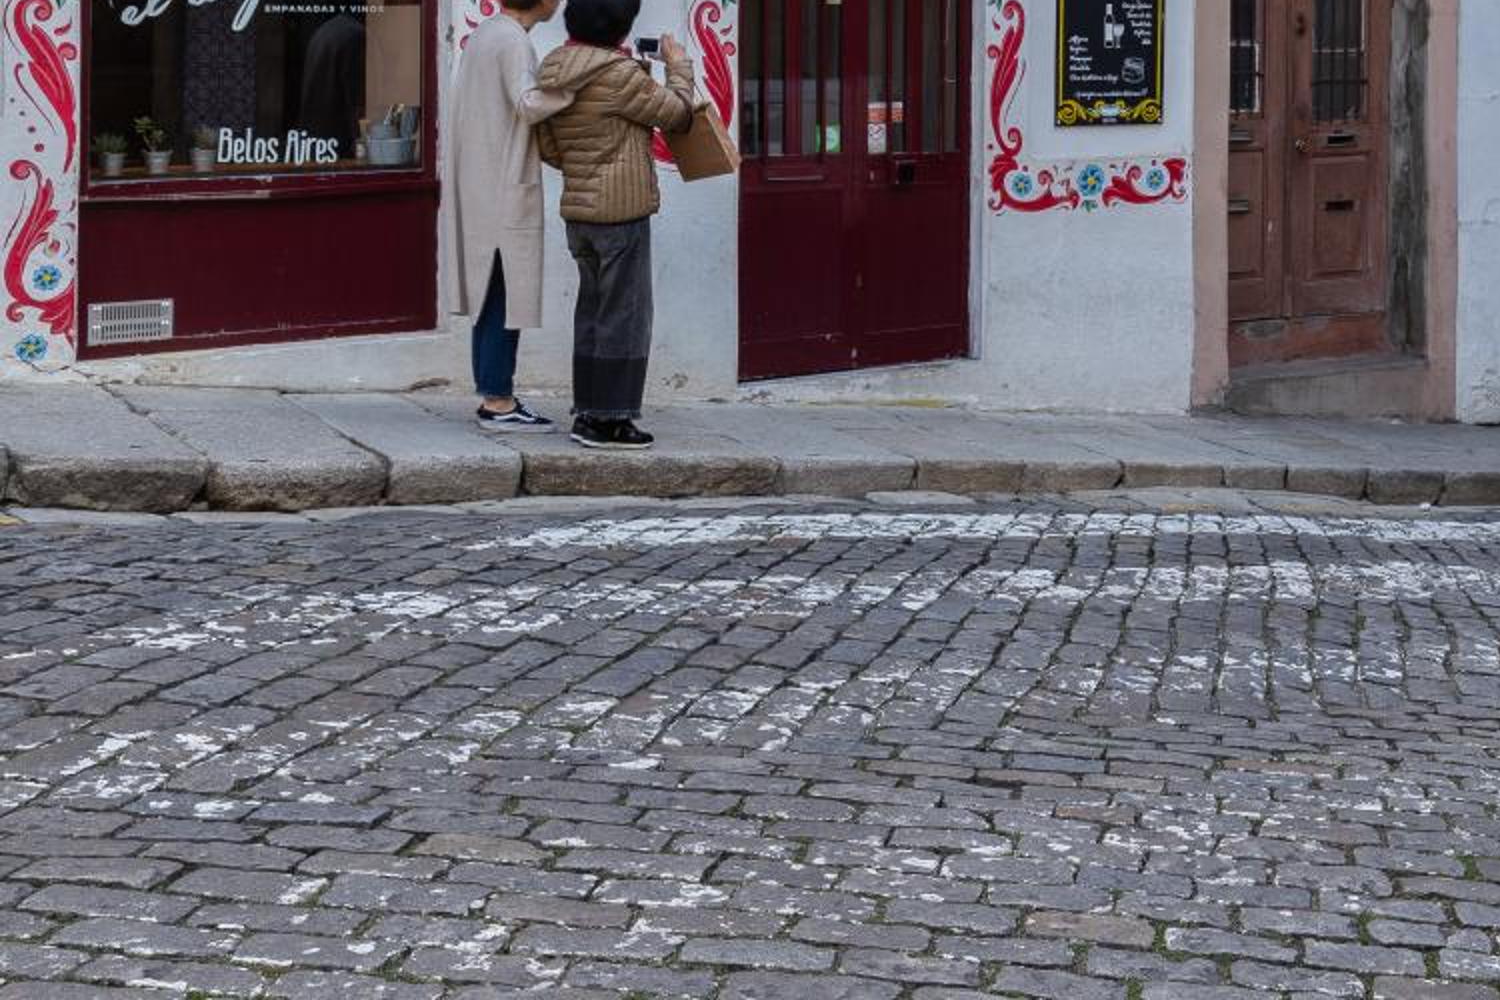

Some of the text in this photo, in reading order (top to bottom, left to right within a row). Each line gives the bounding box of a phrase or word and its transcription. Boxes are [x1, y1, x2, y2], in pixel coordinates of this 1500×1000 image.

[264, 4, 385, 14] EMPANADAS Y VINOS
[217, 127, 339, 165] Belos Aires
